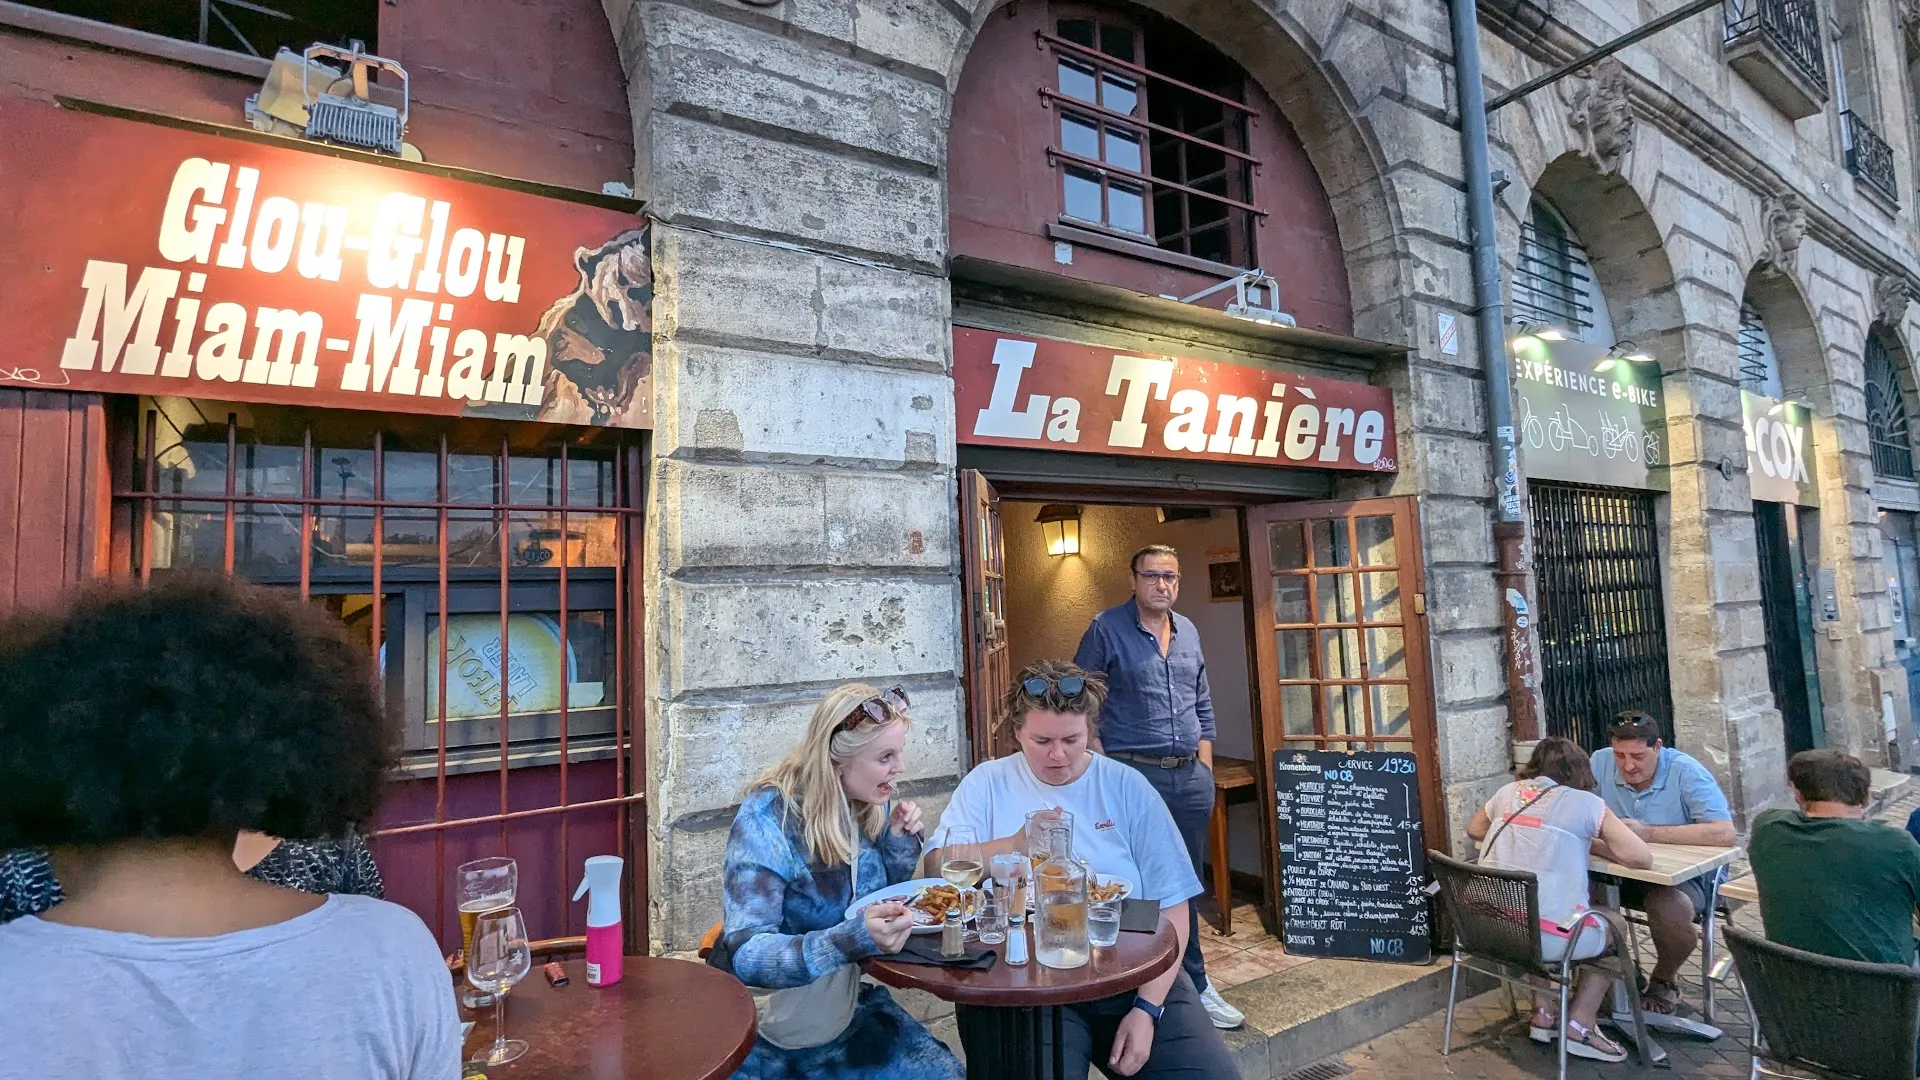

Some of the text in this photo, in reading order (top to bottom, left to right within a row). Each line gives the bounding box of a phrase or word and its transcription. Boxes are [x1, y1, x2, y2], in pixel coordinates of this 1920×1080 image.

[159, 156, 526, 303] Glou-Glou
[60, 260, 548, 406] Miam-Miam
[1515, 357, 1607, 397] EXPÉRIENCE
[973, 338, 1384, 464] La Tanière
[1279, 761, 1321, 774] Kronenbourg
[1338, 758, 1373, 771] SERVICE
[1324, 769, 1354, 782] NO CB
[1287, 864, 1306, 875] POULET
[1296, 877, 1318, 888] MAGRET
[1327, 879, 1350, 890] CANARD
[1290, 918, 1327, 930] CAMEMBERT
[1287, 934, 1316, 946] DESSERTS
[1370, 938, 1385, 954] NO
[1387, 939, 1404, 956] CB
